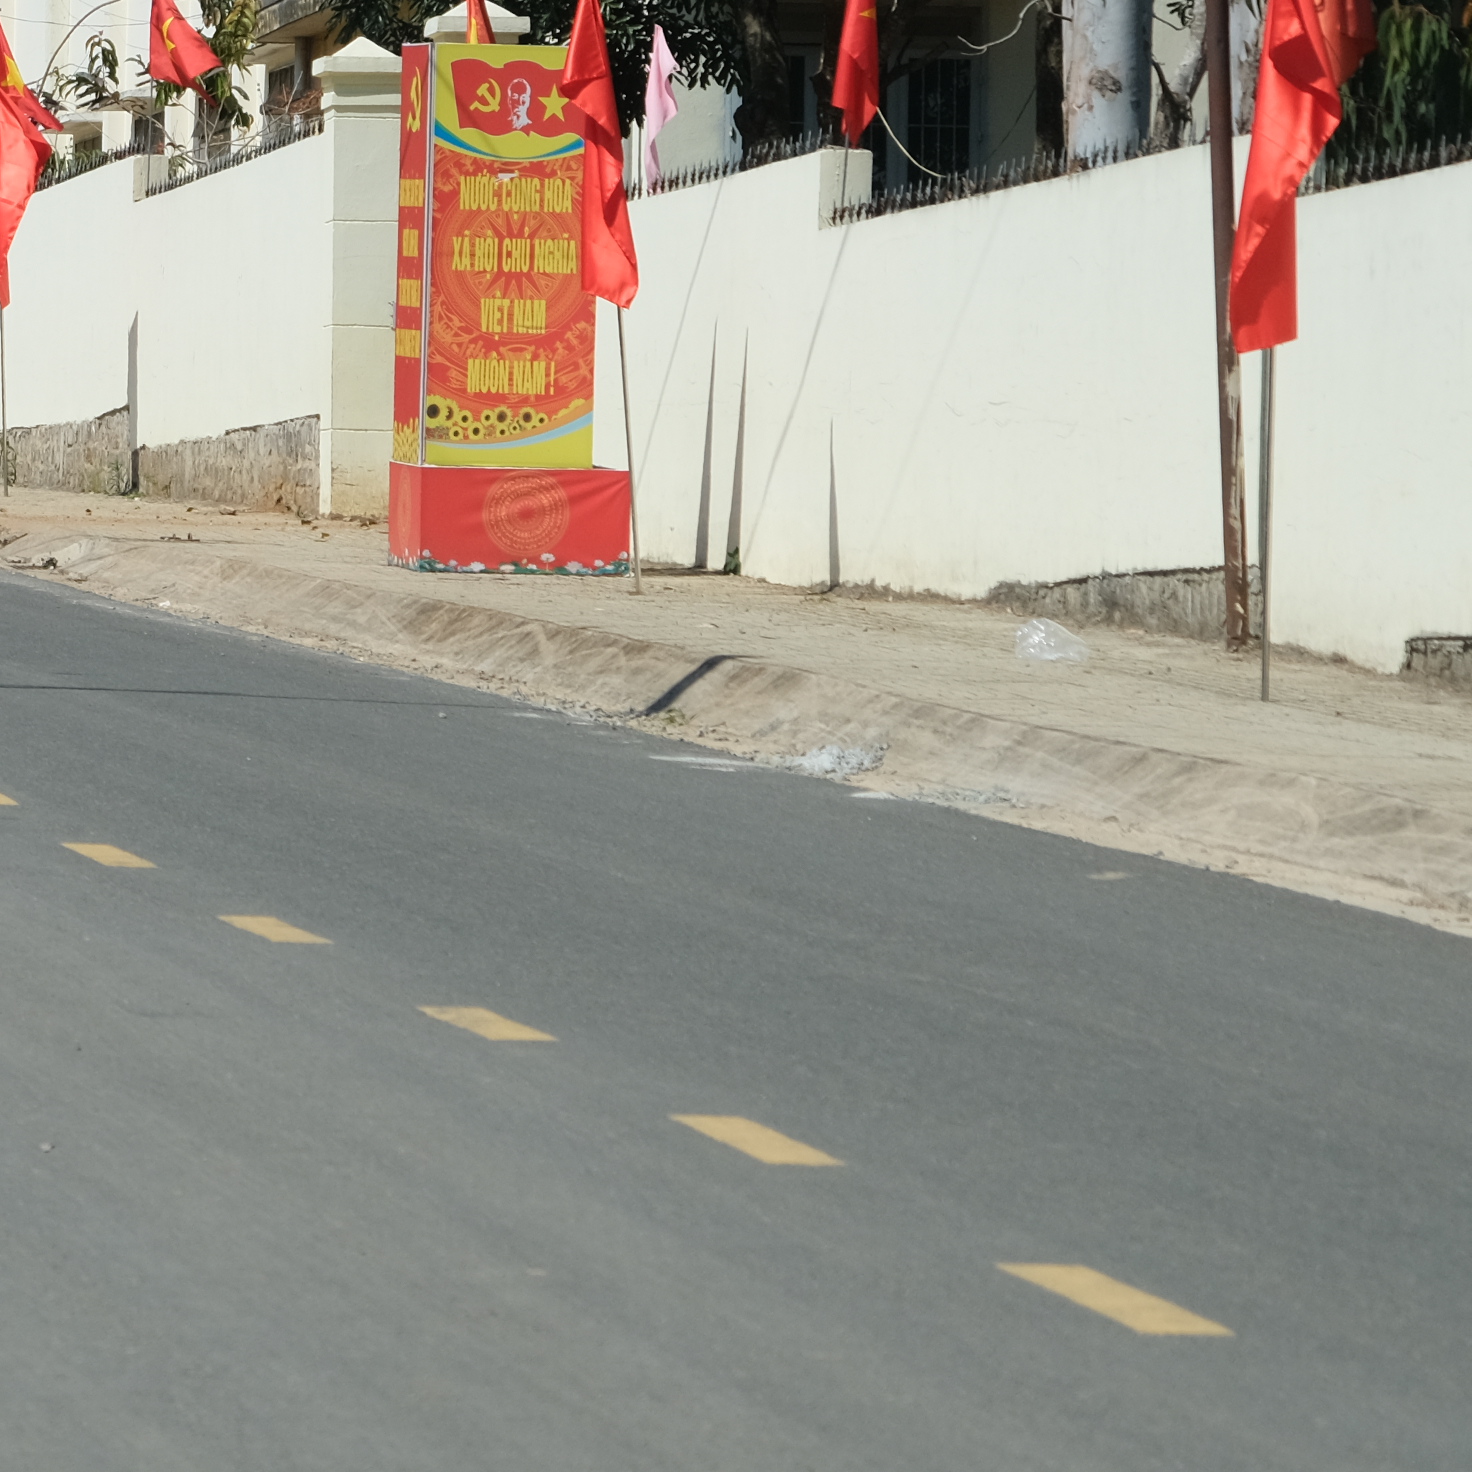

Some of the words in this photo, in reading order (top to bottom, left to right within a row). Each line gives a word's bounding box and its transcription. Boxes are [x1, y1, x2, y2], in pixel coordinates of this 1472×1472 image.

[459, 168, 498, 211] NƯỚC
[502, 170, 540, 220] CỘNG
[544, 170, 573, 213] HÒA
[451, 230, 471, 271] XÃ
[475, 230, 499, 280] HỘI
[502, 226, 530, 273] CHỦ
[533, 233, 577, 274] NGHĨA
[480, 290, 510, 340] VIỆT
[513, 299, 546, 334] NAM
[467, 350, 509, 394] MUÔN
[512, 352, 546, 395] NĂM
